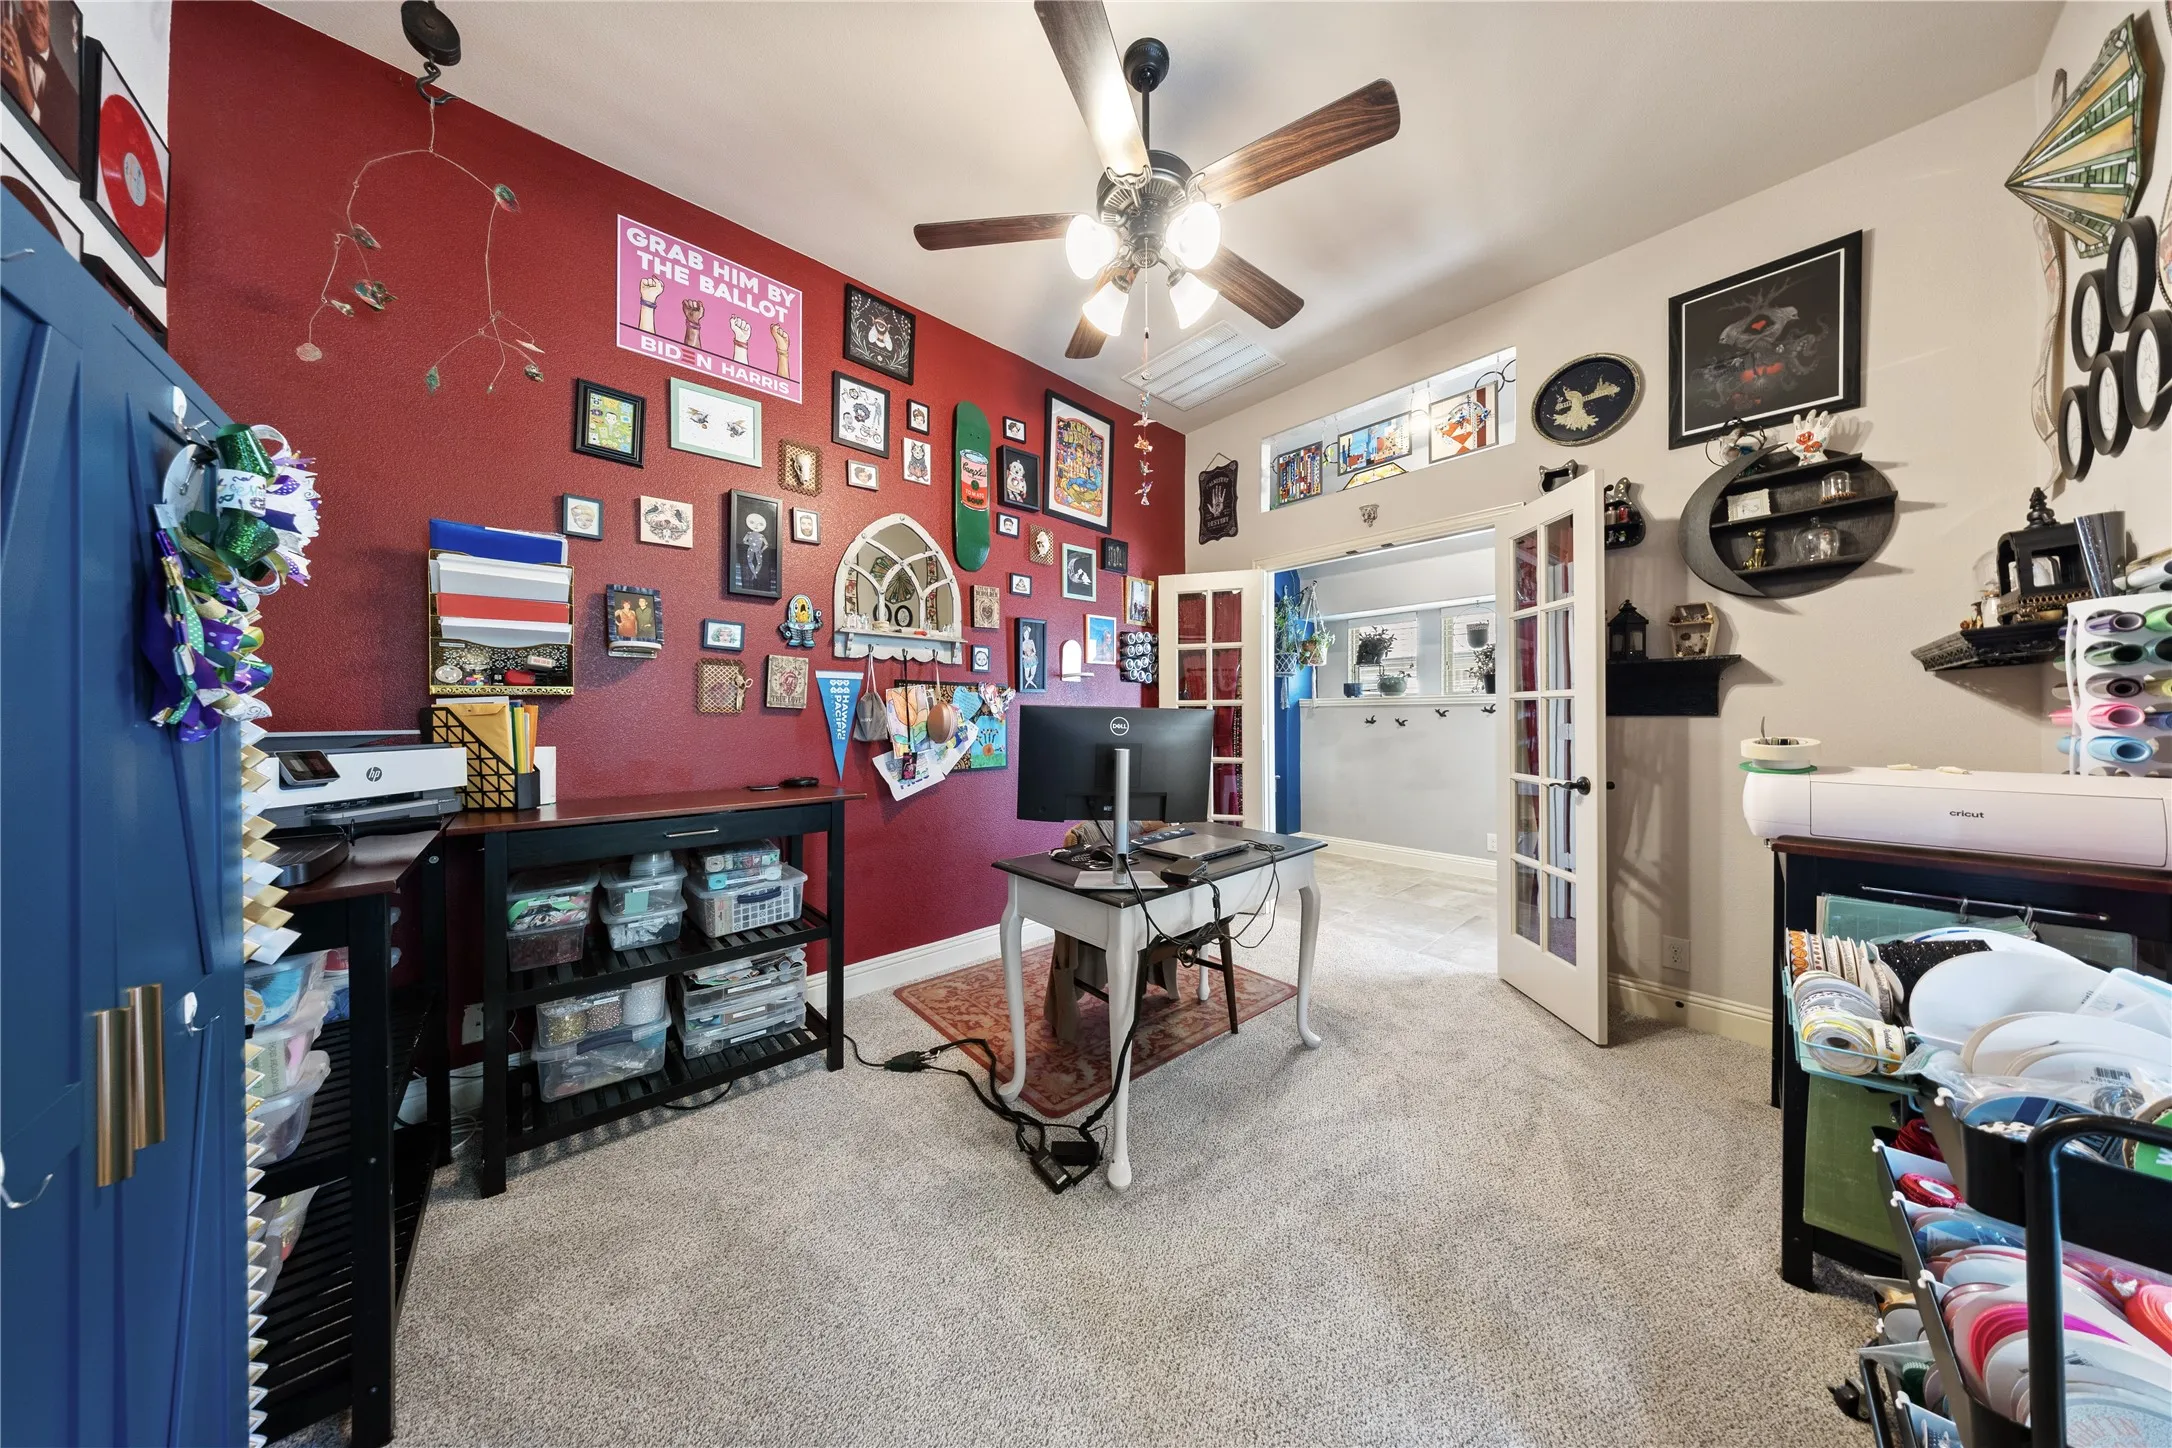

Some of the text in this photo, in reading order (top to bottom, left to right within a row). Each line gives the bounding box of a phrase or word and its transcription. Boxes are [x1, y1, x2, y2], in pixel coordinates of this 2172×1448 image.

[626, 227, 796, 307] GRAB HIM BY
[636, 250, 788, 323] THE BALLOT
[640, 335, 790, 394] BIDEN HARRIS
[367, 767, 381, 782] hp
[1949, 809, 1985, 819] cricut
